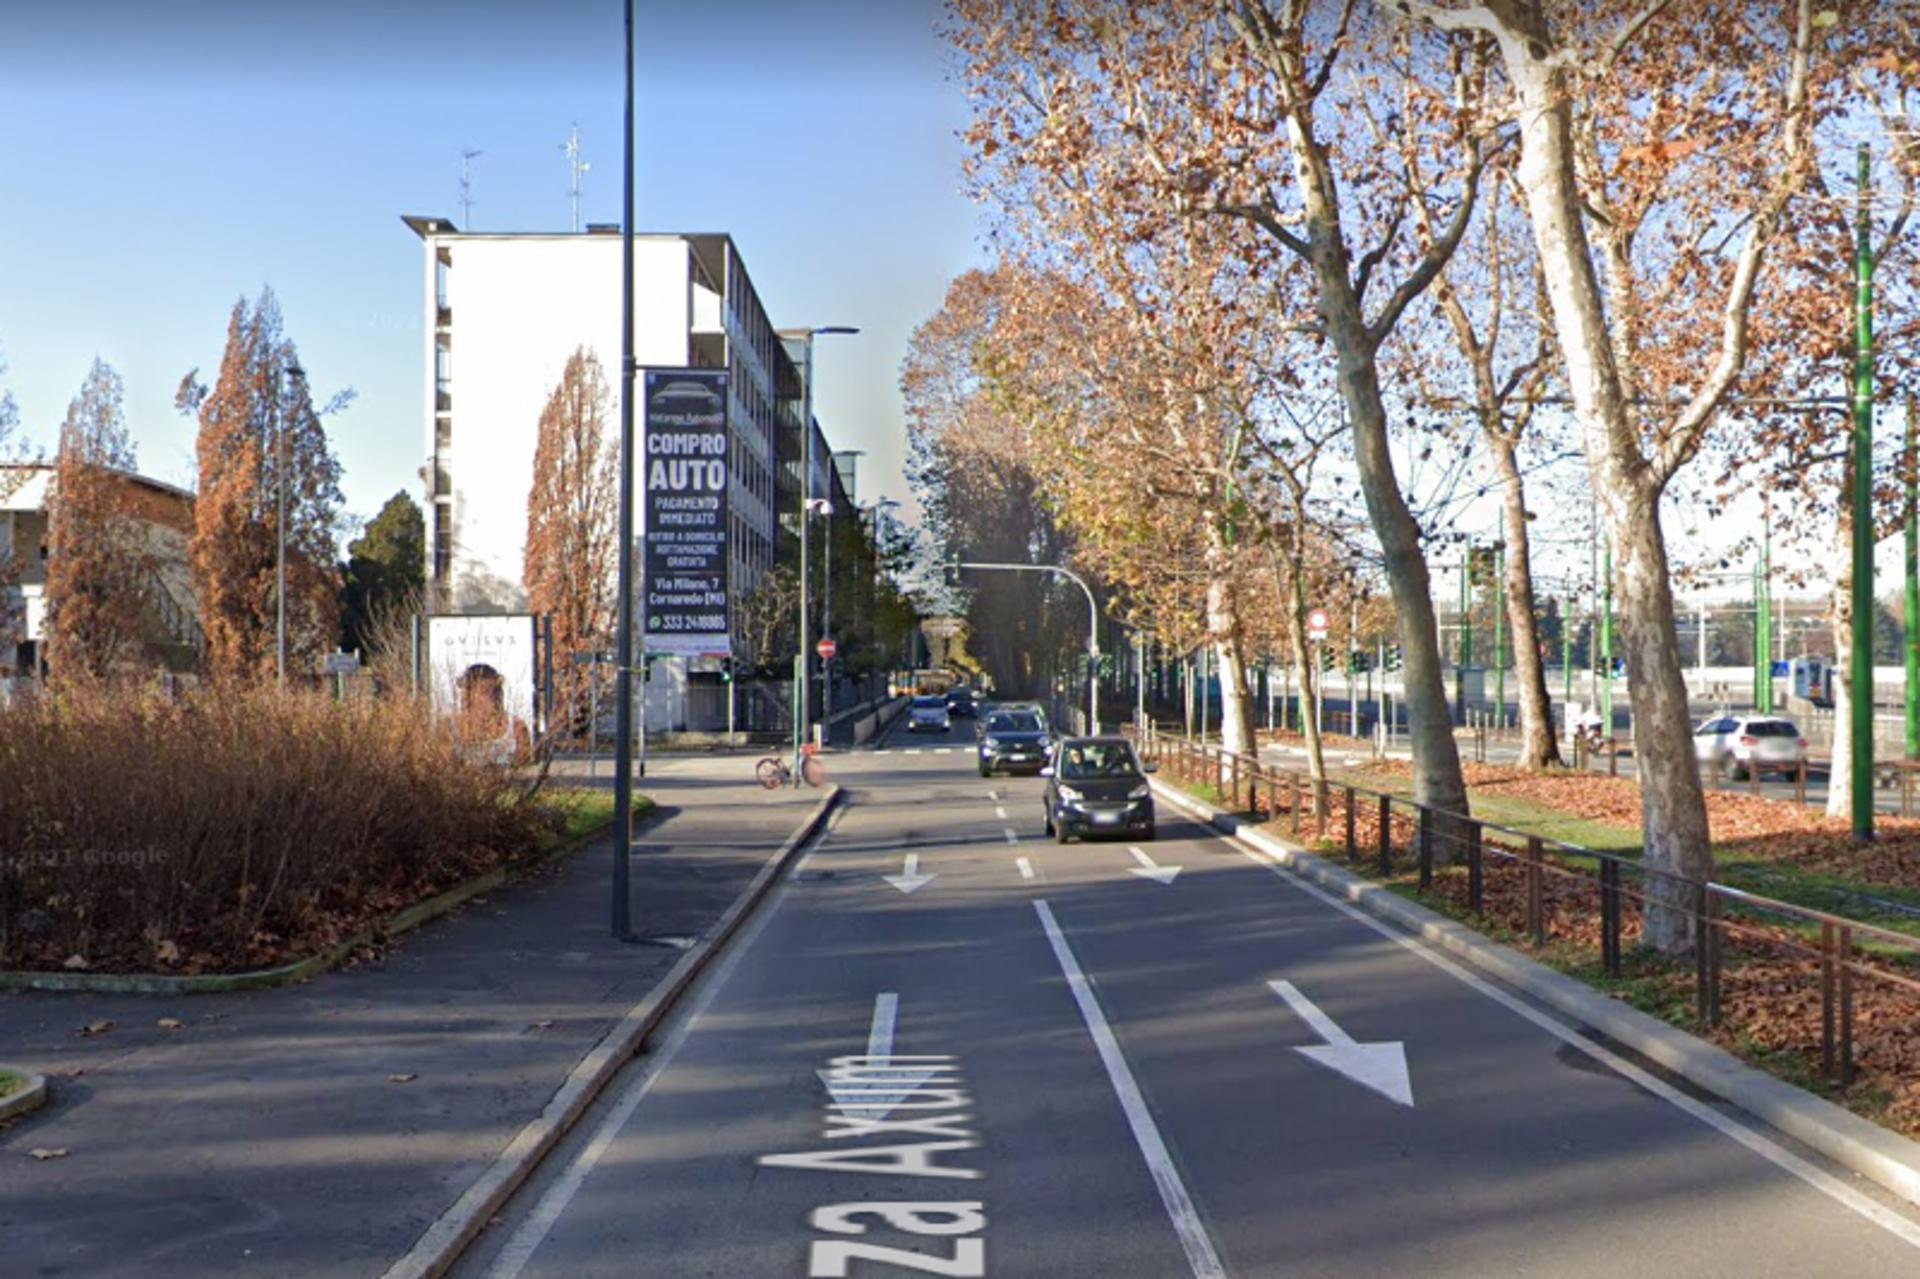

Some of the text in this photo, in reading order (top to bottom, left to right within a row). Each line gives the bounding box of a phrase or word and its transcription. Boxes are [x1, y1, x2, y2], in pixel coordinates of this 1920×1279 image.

[648, 433, 726, 454] COMPRO
[648, 459, 726, 490] AUTO
[654, 496, 719, 510] PAGAMENTO
[659, 512, 716, 525] IMMEDIATO
[655, 577, 672, 590] Via
[712, 577, 720, 590] 7
[649, 592, 704, 605] Cornaredo
[662, 614, 682, 630] 333
